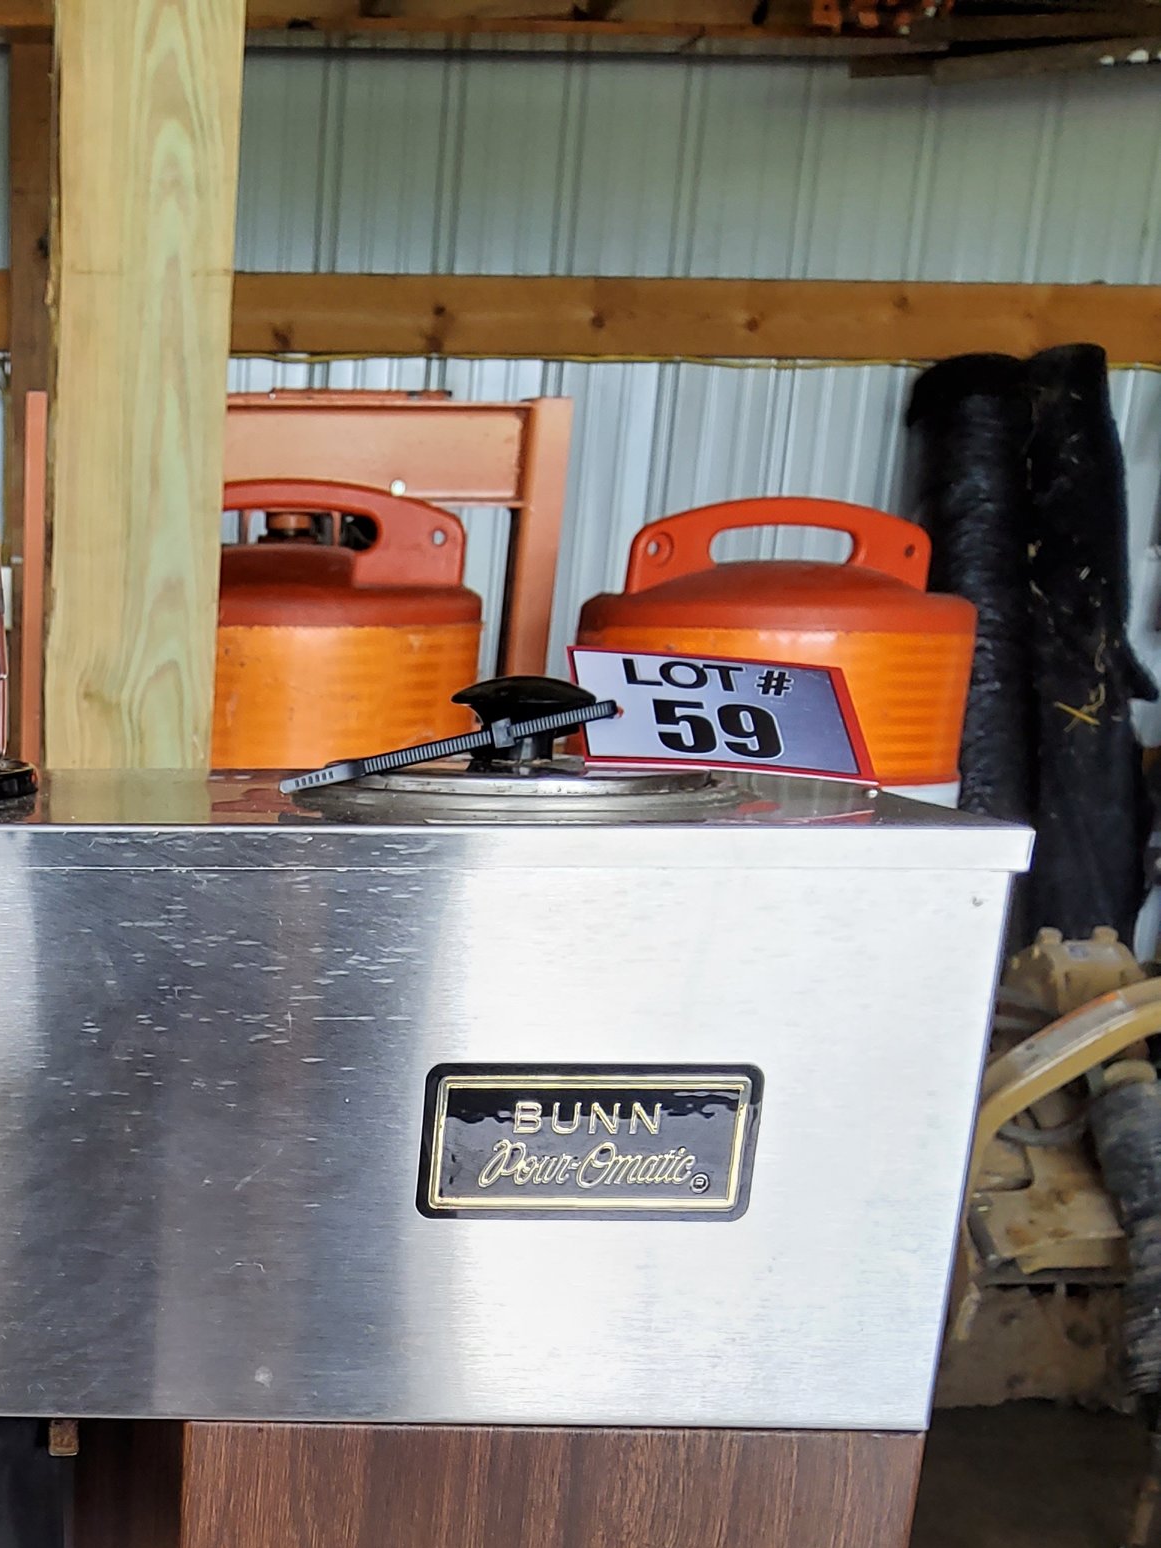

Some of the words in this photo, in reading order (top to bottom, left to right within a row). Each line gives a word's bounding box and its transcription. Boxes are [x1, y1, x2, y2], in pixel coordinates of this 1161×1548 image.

[622, 657, 743, 692] LOT
[756, 669, 792, 697] #
[652, 698, 782, 759] 59
[512, 1101, 663, 1135] BUNN
